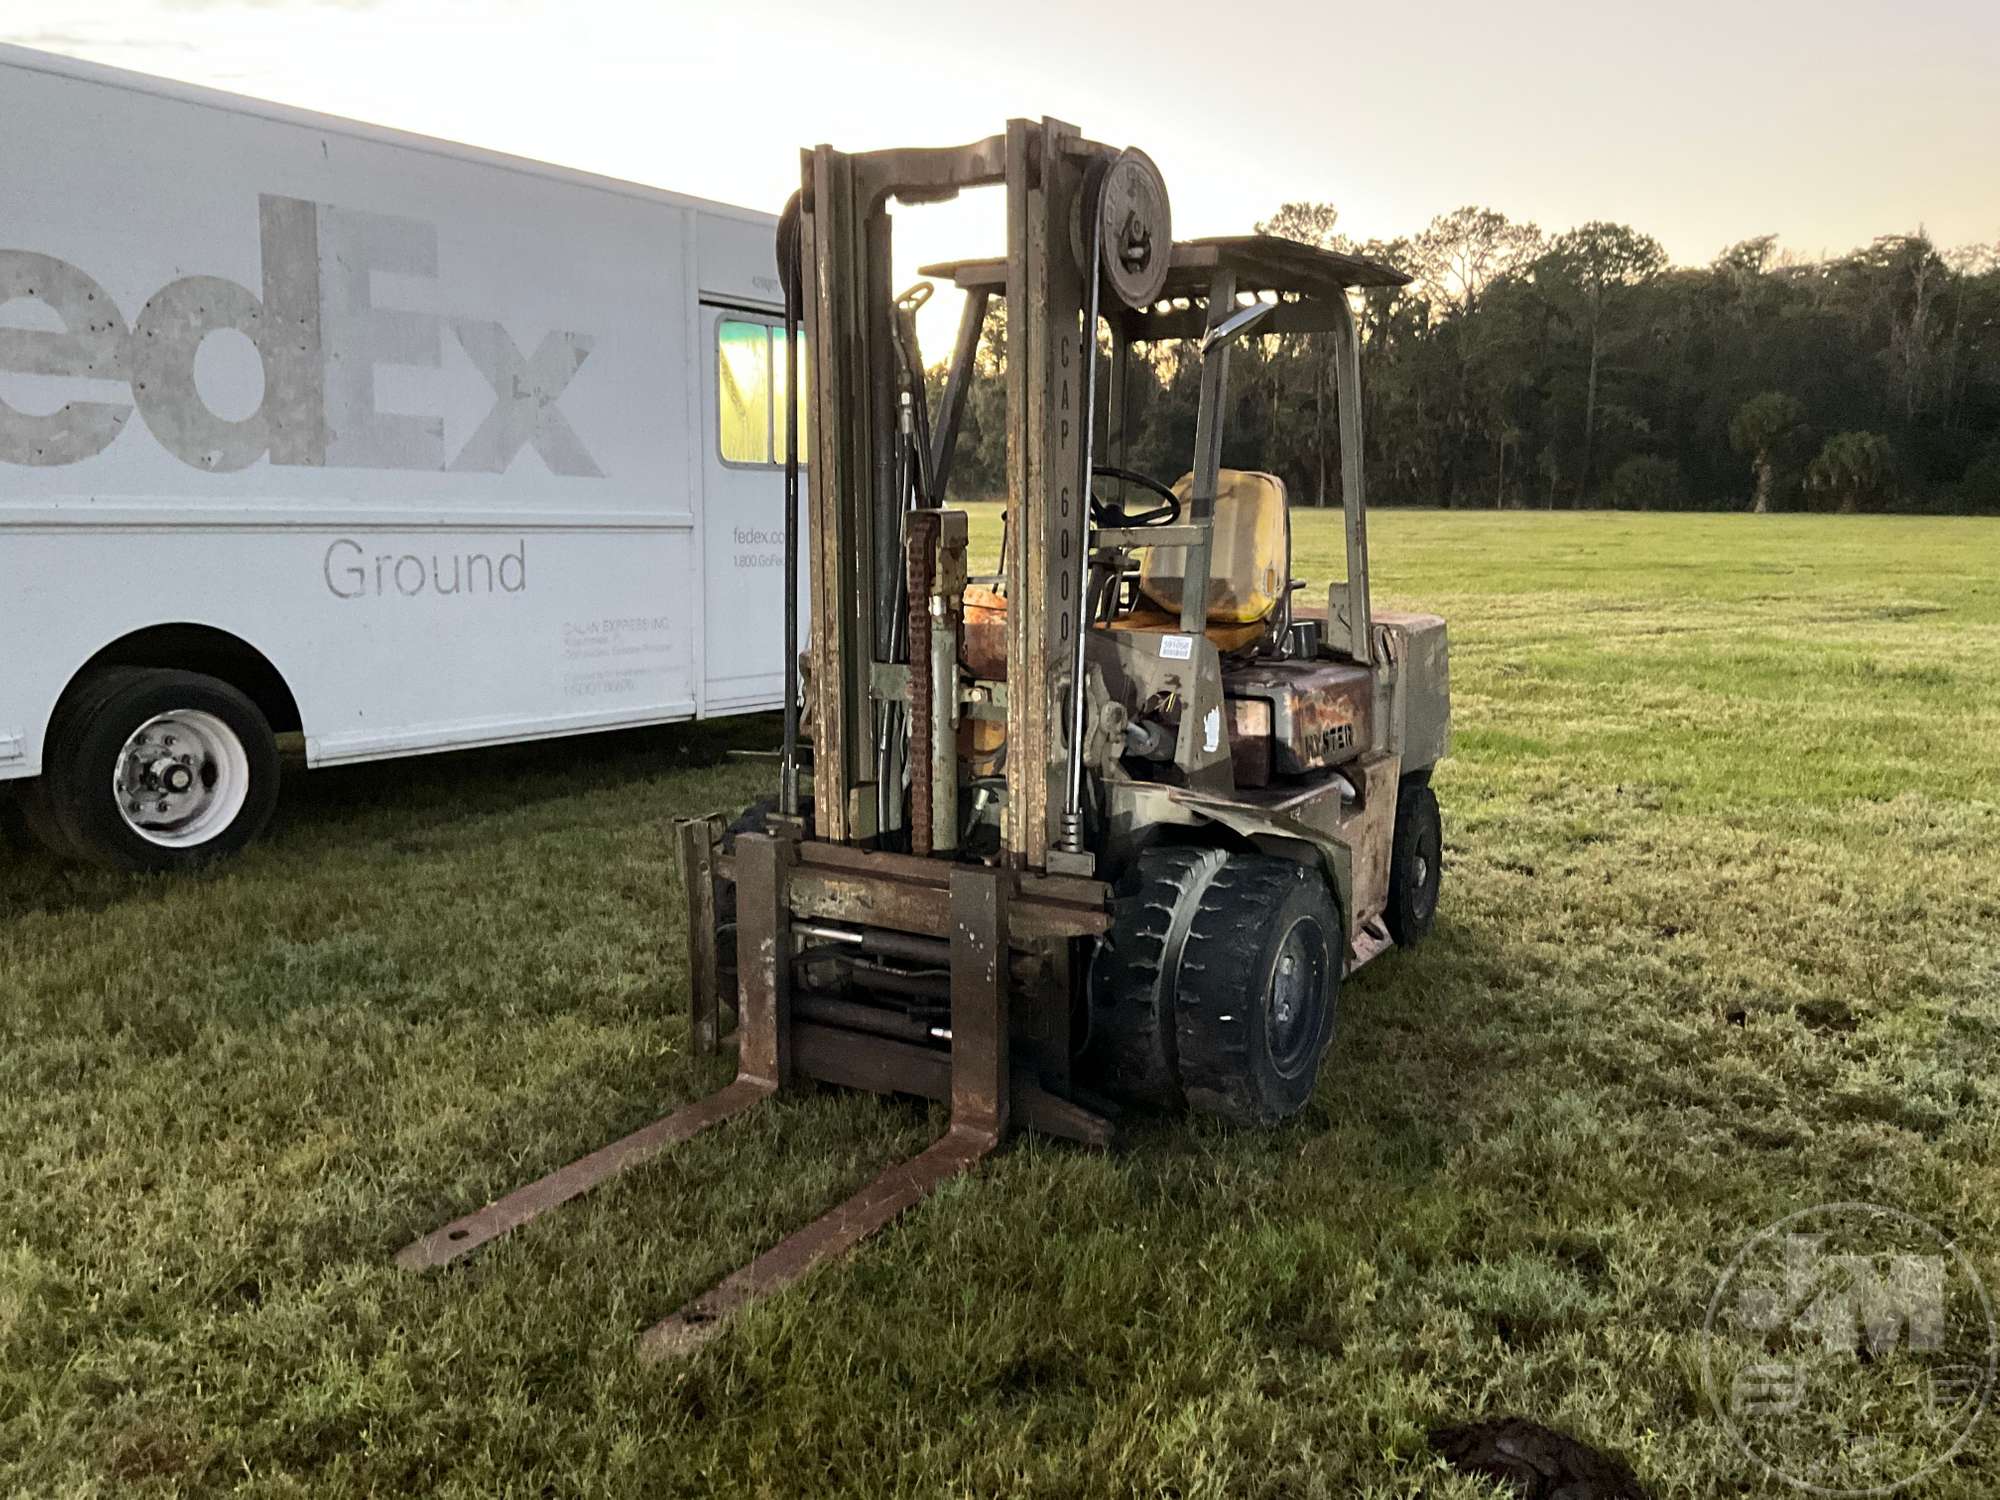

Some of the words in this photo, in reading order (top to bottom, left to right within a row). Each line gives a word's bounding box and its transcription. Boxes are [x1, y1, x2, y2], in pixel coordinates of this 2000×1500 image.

[0, 193, 605, 478] edEx
[1060, 335, 1070, 450] CAP
[323, 537, 527, 599] Ground
[734, 525, 785, 545] fedex.co
[1059, 486, 1070, 641] 6000
